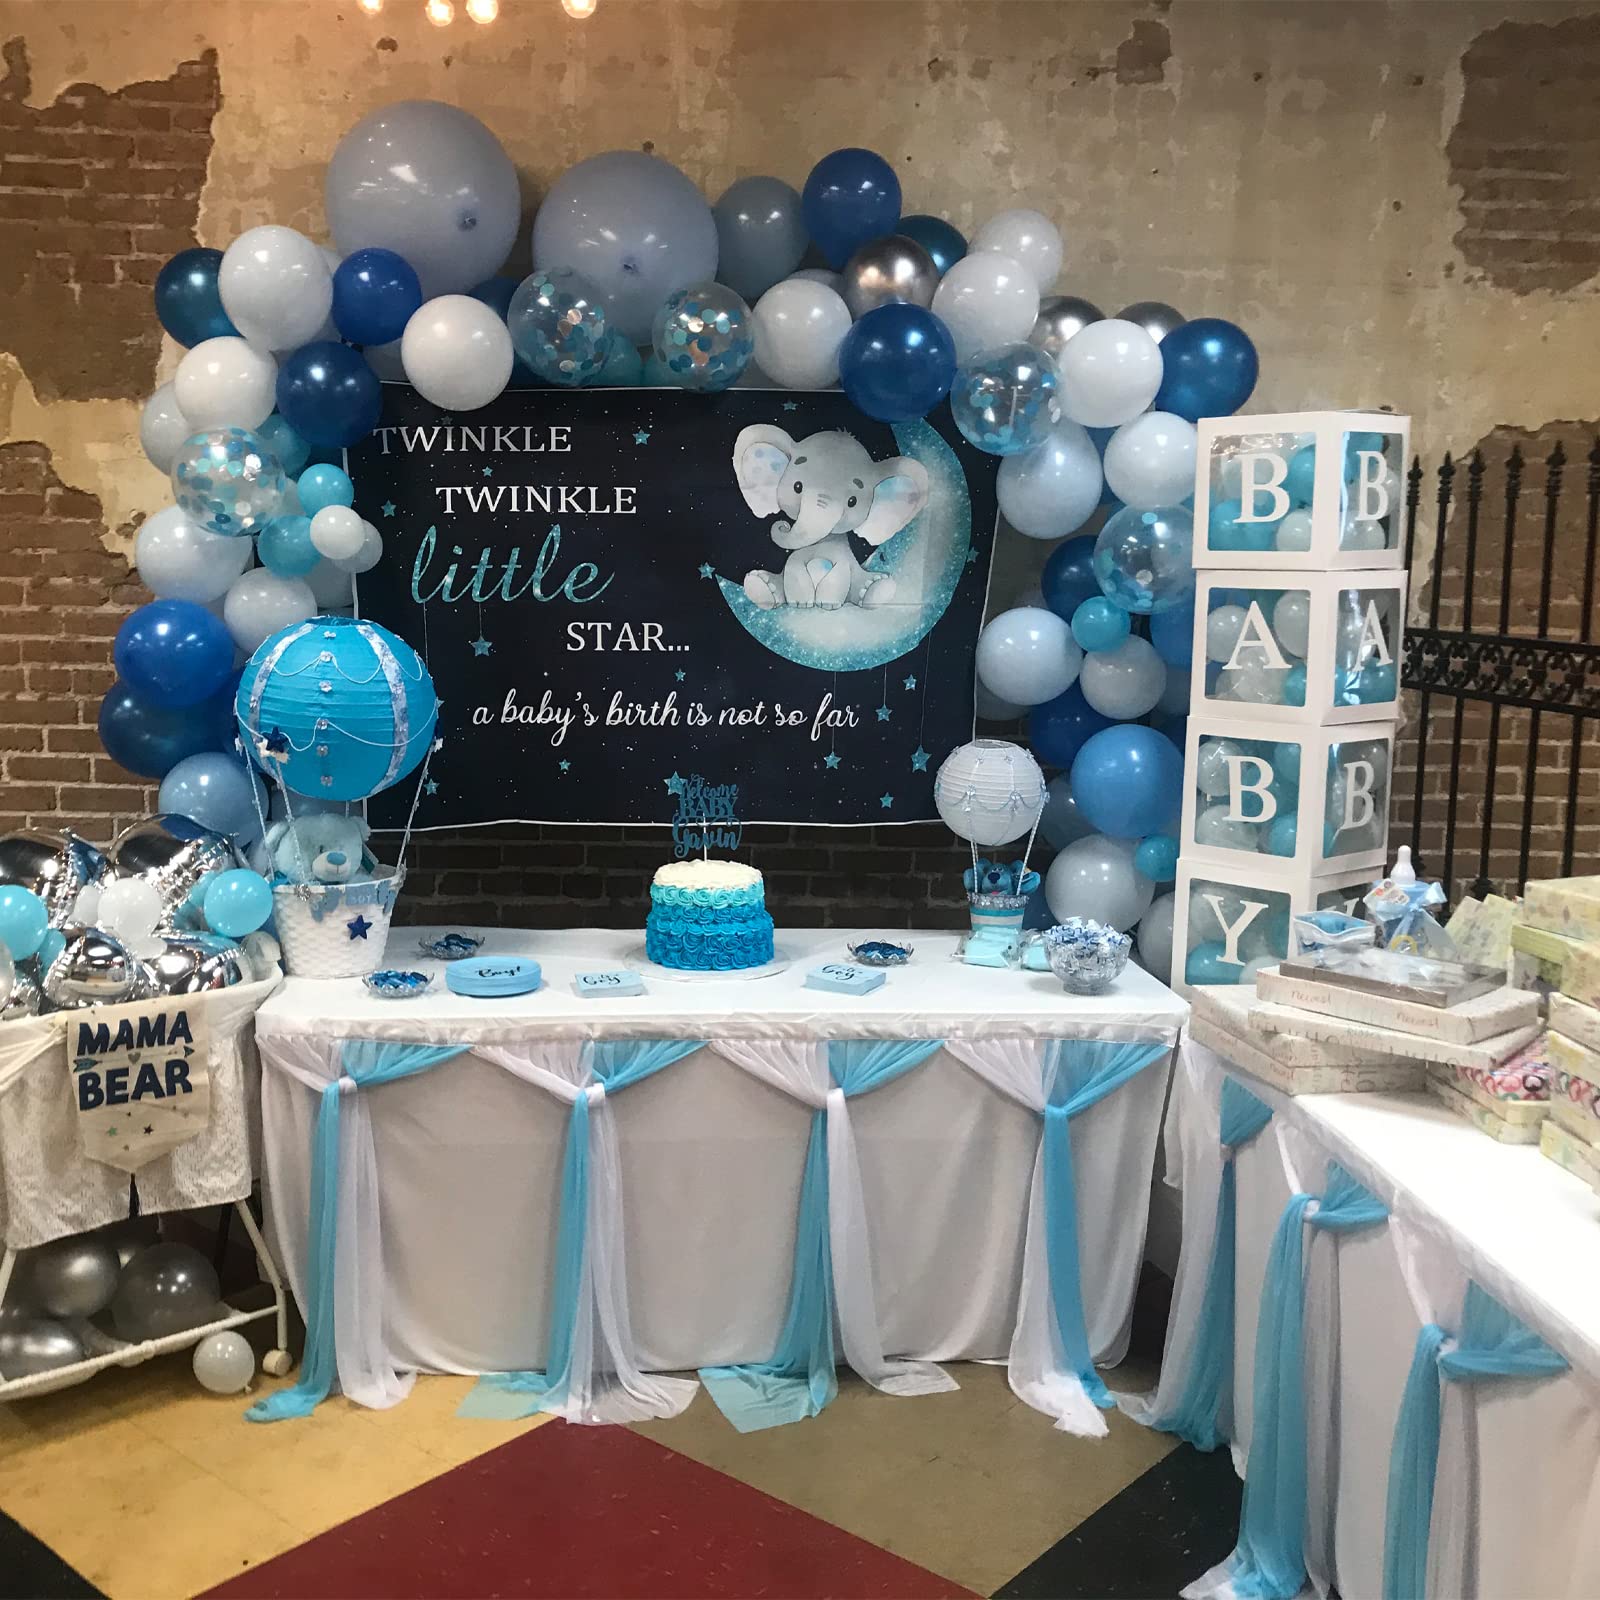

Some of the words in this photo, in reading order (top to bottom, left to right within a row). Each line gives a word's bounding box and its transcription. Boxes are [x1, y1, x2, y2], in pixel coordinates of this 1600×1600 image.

[373, 426, 572, 454] TWINKLE
[436, 486, 637, 514] TWINKLE
[411, 524, 615, 603] little
[566, 622, 690, 652] STAR...
[472, 707, 494, 725] a
[500, 689, 599, 747] baby's
[605, 691, 680, 726] birth
[686, 702, 712, 727] is
[718, 704, 768, 727] not
[774, 703, 807, 727] so
[810, 692, 860, 741] far
[678, 796, 738, 818] BABY
[76, 1010, 193, 1056] MAMA
[78, 1059, 193, 1111] BEAR
